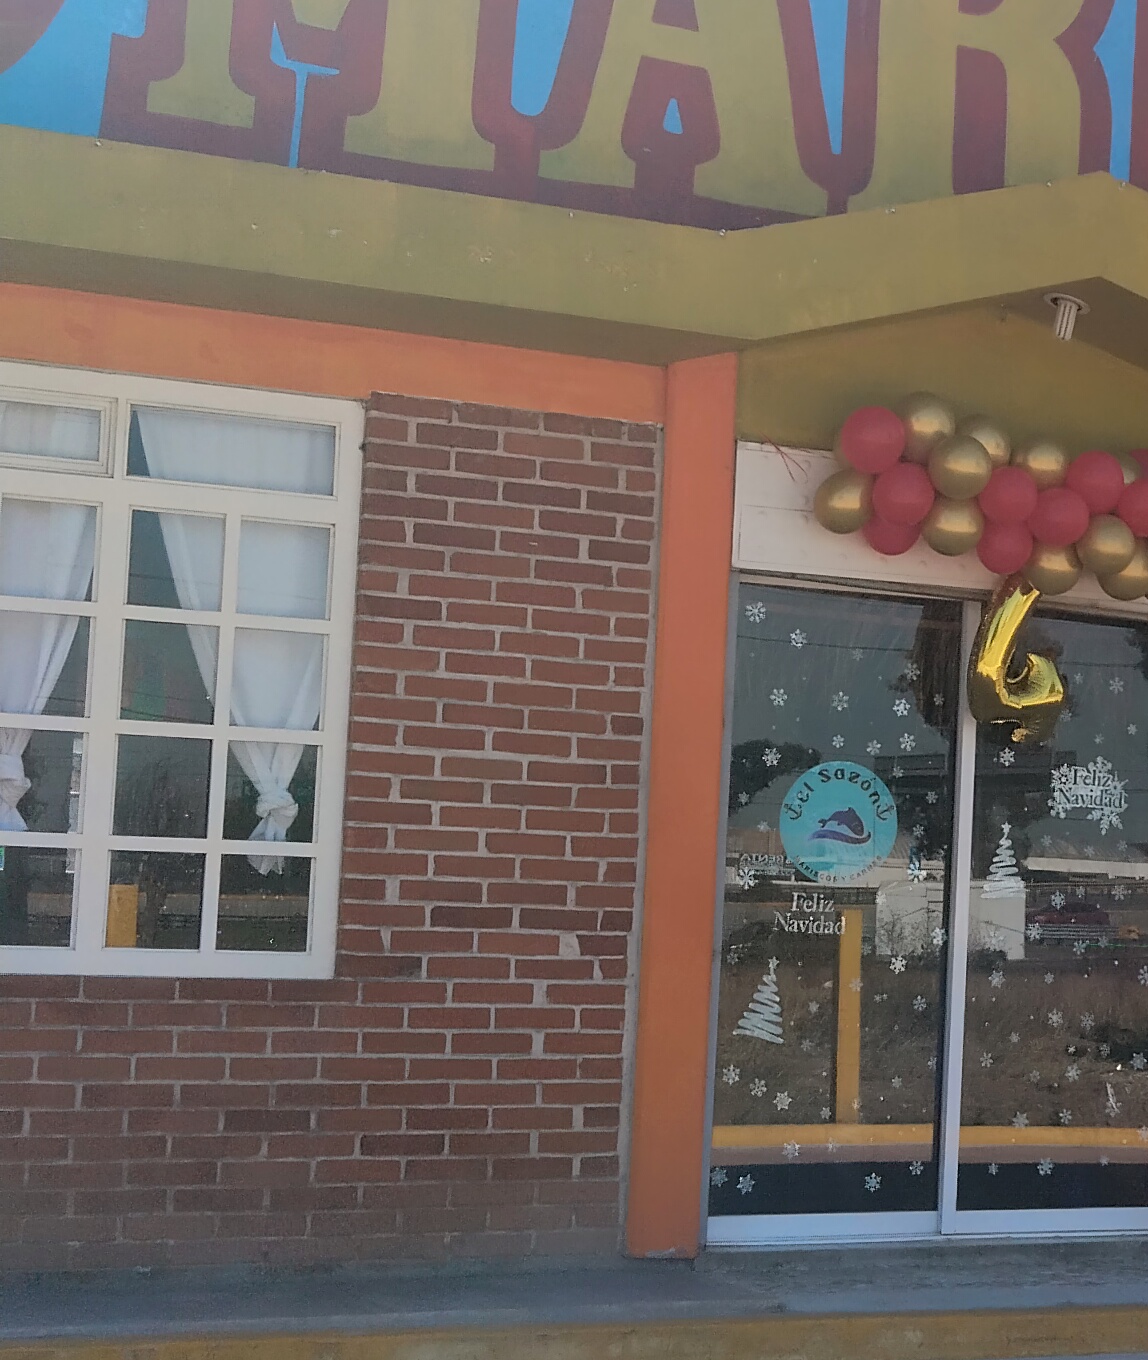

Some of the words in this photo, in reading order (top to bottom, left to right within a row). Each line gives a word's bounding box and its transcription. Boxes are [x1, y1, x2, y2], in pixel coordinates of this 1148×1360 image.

[1072, 767, 1112, 787] Feliz
[1058, 786, 1124, 809] Navidad
[791, 892, 835, 912] Feliz
[773, 911, 847, 935] Navidad
